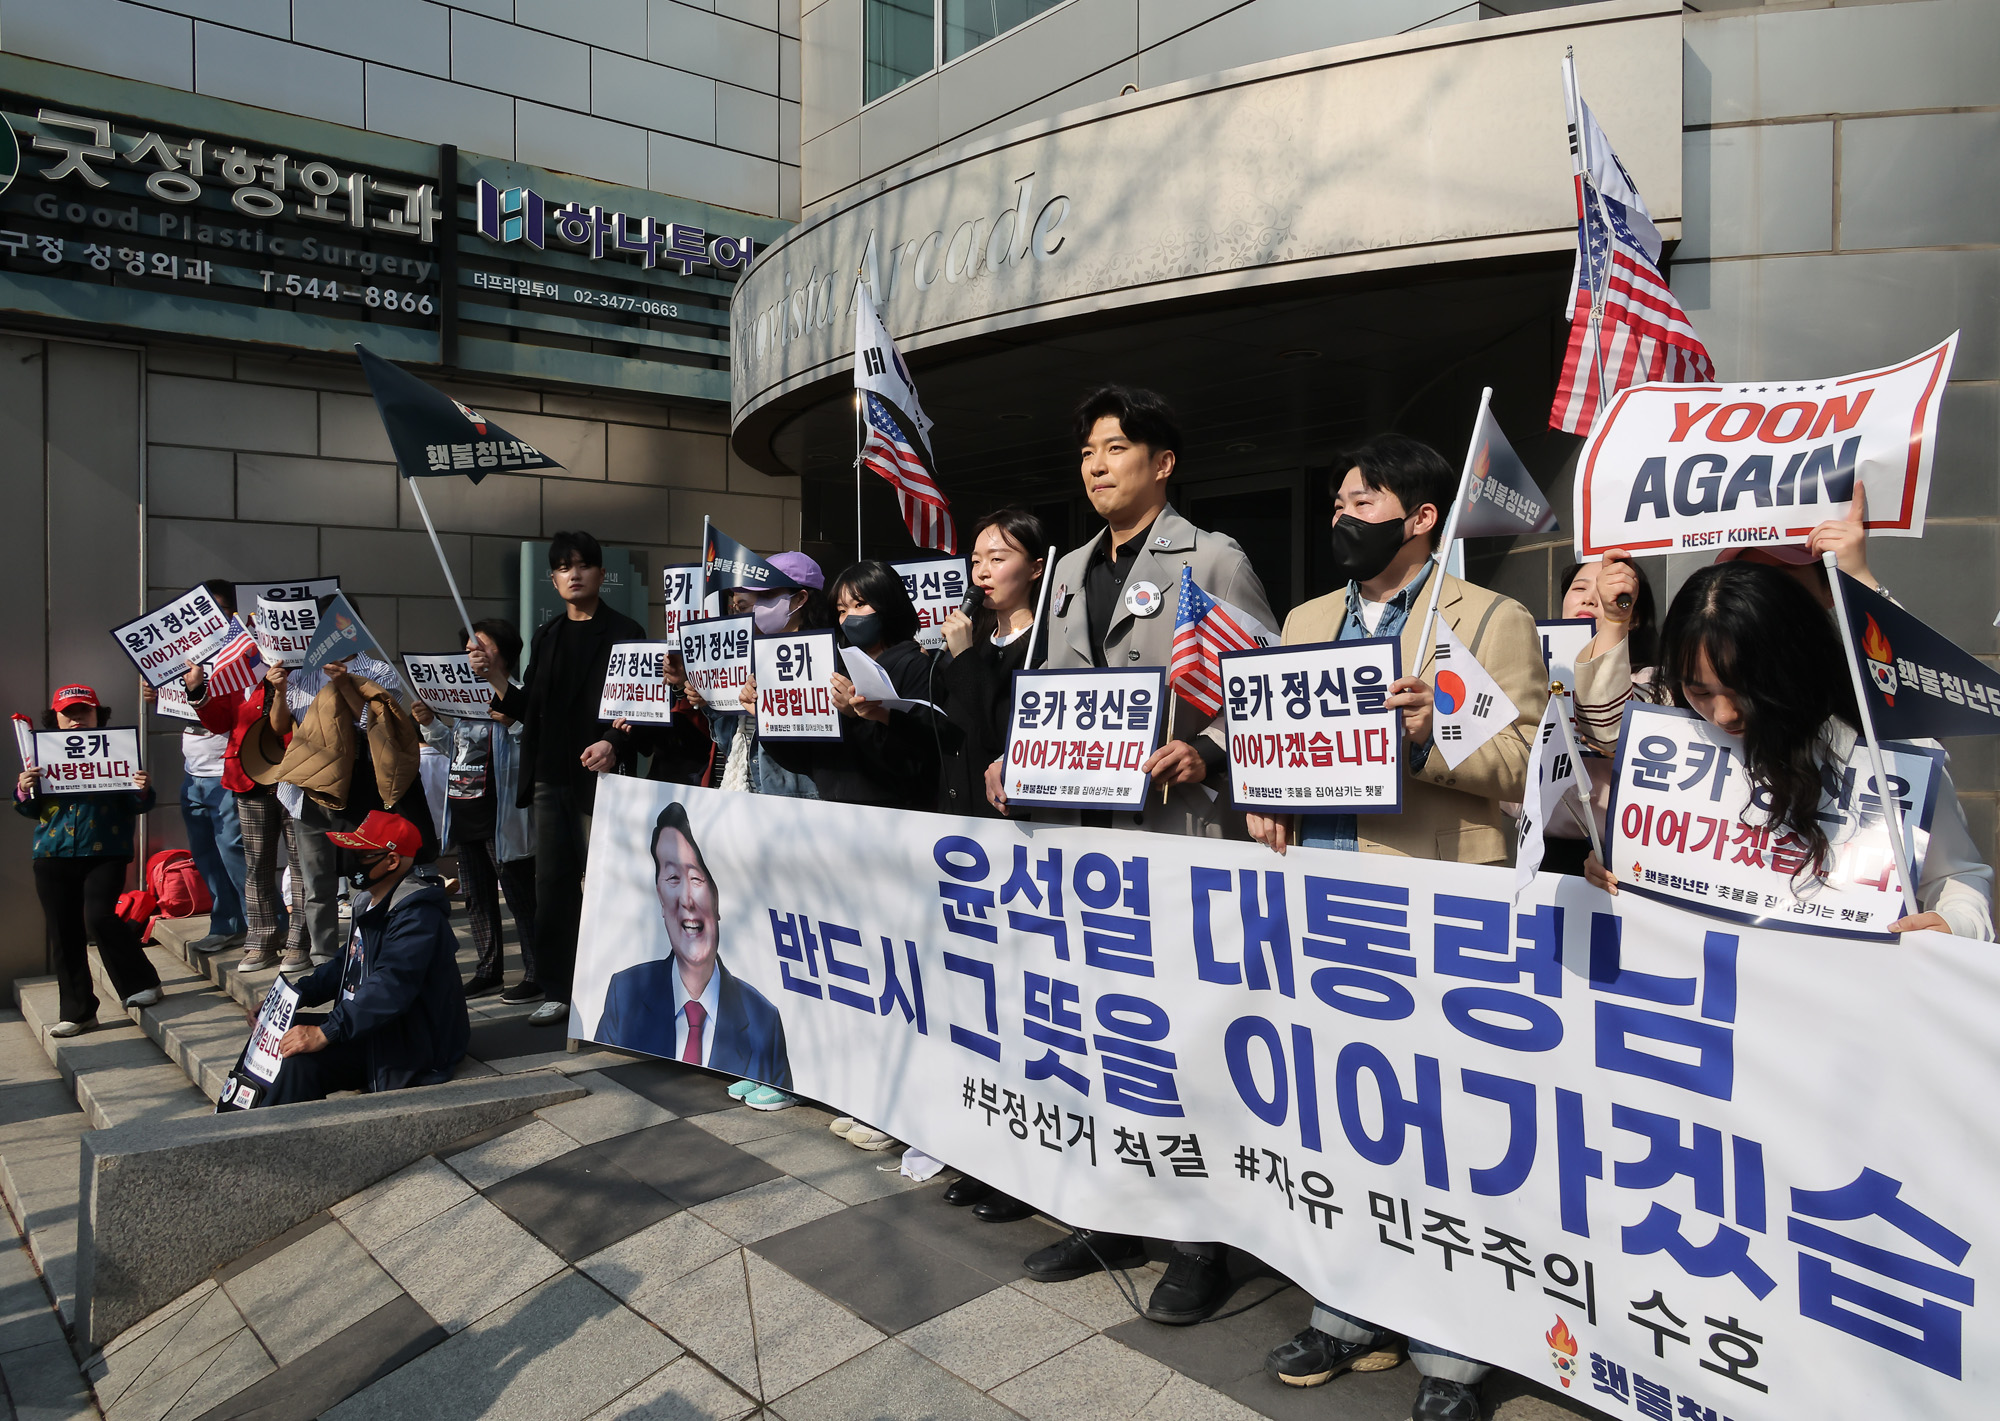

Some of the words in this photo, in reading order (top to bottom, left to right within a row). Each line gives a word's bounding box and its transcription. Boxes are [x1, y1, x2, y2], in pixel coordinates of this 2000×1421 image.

[32, 108, 442, 243] 굿성형외과
[34, 192, 140, 234] Good
[158, 211, 286, 256] Plastic
[303, 236, 433, 284] Surgery
[554, 201, 754, 276] 하나투어
[846, 171, 1071, 318] Arcade
[83, 240, 213, 285] 성형외과
[473, 272, 560, 300] 더프라임투어
[573, 289, 678, 318] 02-3477-0663
[1668, 388, 1875, 443] YOON
[1482, 475, 1541, 526] 횃불청년단
[1624, 434, 1862, 523] AGAIN
[1682, 530, 1724, 547] RESET
[1727, 526, 1779, 543] KOREA
[900, 570, 964, 602] 정신을
[125, 623, 165, 653] 윤카
[160, 595, 213, 633] 정신을
[268, 608, 317, 631] 정신을
[608, 653, 626, 677] 윤카
[628, 653, 665, 677] 정신을
[684, 634, 707, 664] 윤카
[709, 629, 750, 661] 정신을
[776, 643, 812, 681] 윤카
[410, 663, 440, 683] 윤카
[1229, 674, 1273, 721] 윤카
[1281, 665, 1388, 720] 정신을
[761, 687, 835, 717] 사랑합니다.
[1018, 690, 1067, 730] 윤카
[1074, 689, 1152, 730] 정신을
[64, 734, 110, 758] 윤카
[1232, 728, 1395, 769] 이어가겠습니다.
[1631, 735, 1733, 802] 윤카
[45, 760, 136, 781] 사랑합니다.
[1644, 868, 1710, 896] 횃불청년단
[932, 835, 1156, 978] 윤석열
[1191, 866, 1740, 1101] 대통령님
[768, 907, 929, 1036] 반드시
[943, 951, 1002, 1063] 그
[1022, 970, 1186, 1118] 뜻을
[962, 1076, 1098, 1167] #부정선거
[1113, 1126, 1209, 1179] 척결
[1234, 1145, 1344, 1230] #자유
[1367, 1190, 1597, 1327] 민주주의
[1627, 1289, 1769, 1394] 수호
